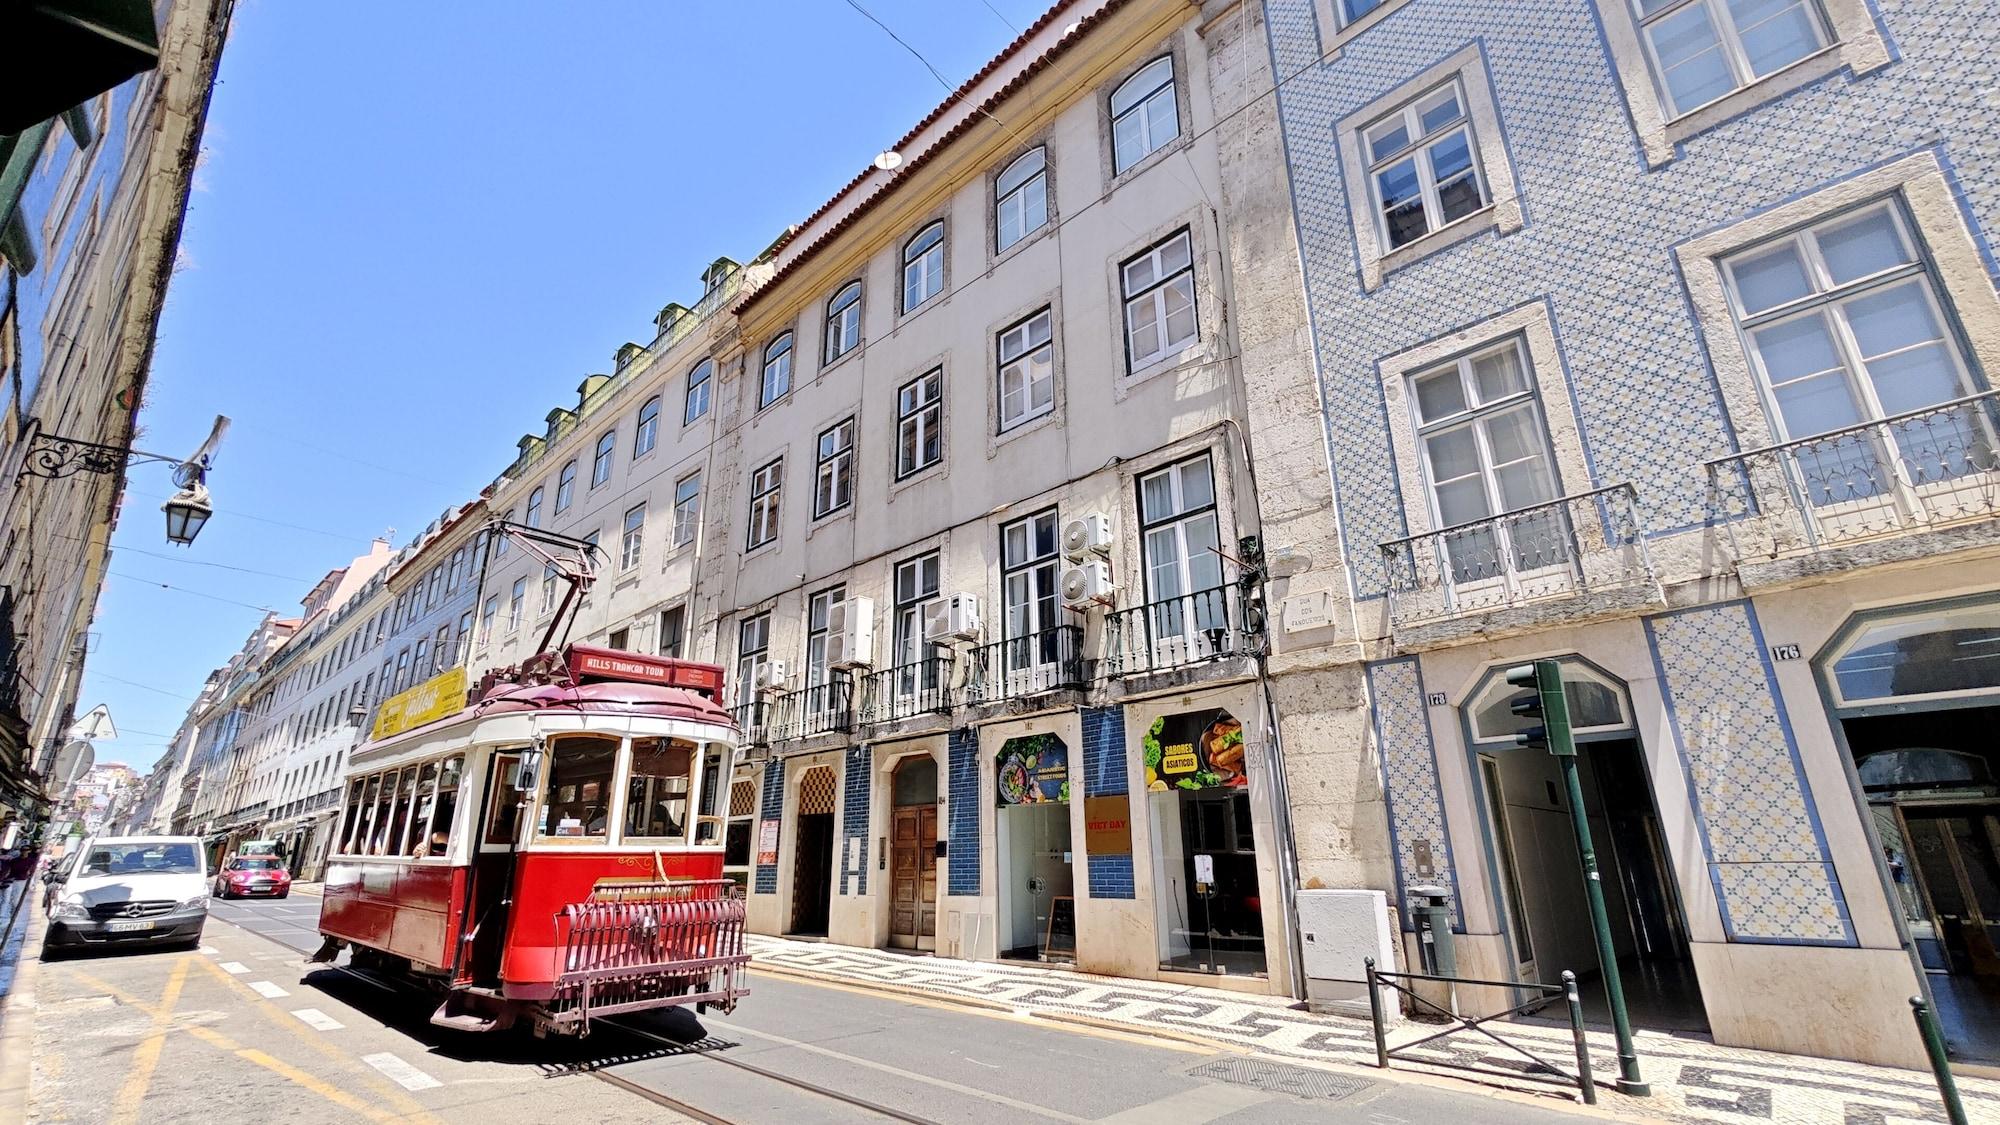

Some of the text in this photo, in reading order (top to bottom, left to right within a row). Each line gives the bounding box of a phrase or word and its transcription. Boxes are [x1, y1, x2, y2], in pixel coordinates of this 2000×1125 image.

[1774, 645, 1799, 660] 176
[587, 658, 611, 669] HILLS
[645, 666, 664, 677] TOUR
[1430, 693, 1445, 705] 178
[1164, 743, 1193, 755] SABORES
[1166, 758, 1194, 768] ASIATICOS
[1088, 819, 1126, 830] VIET DAY
